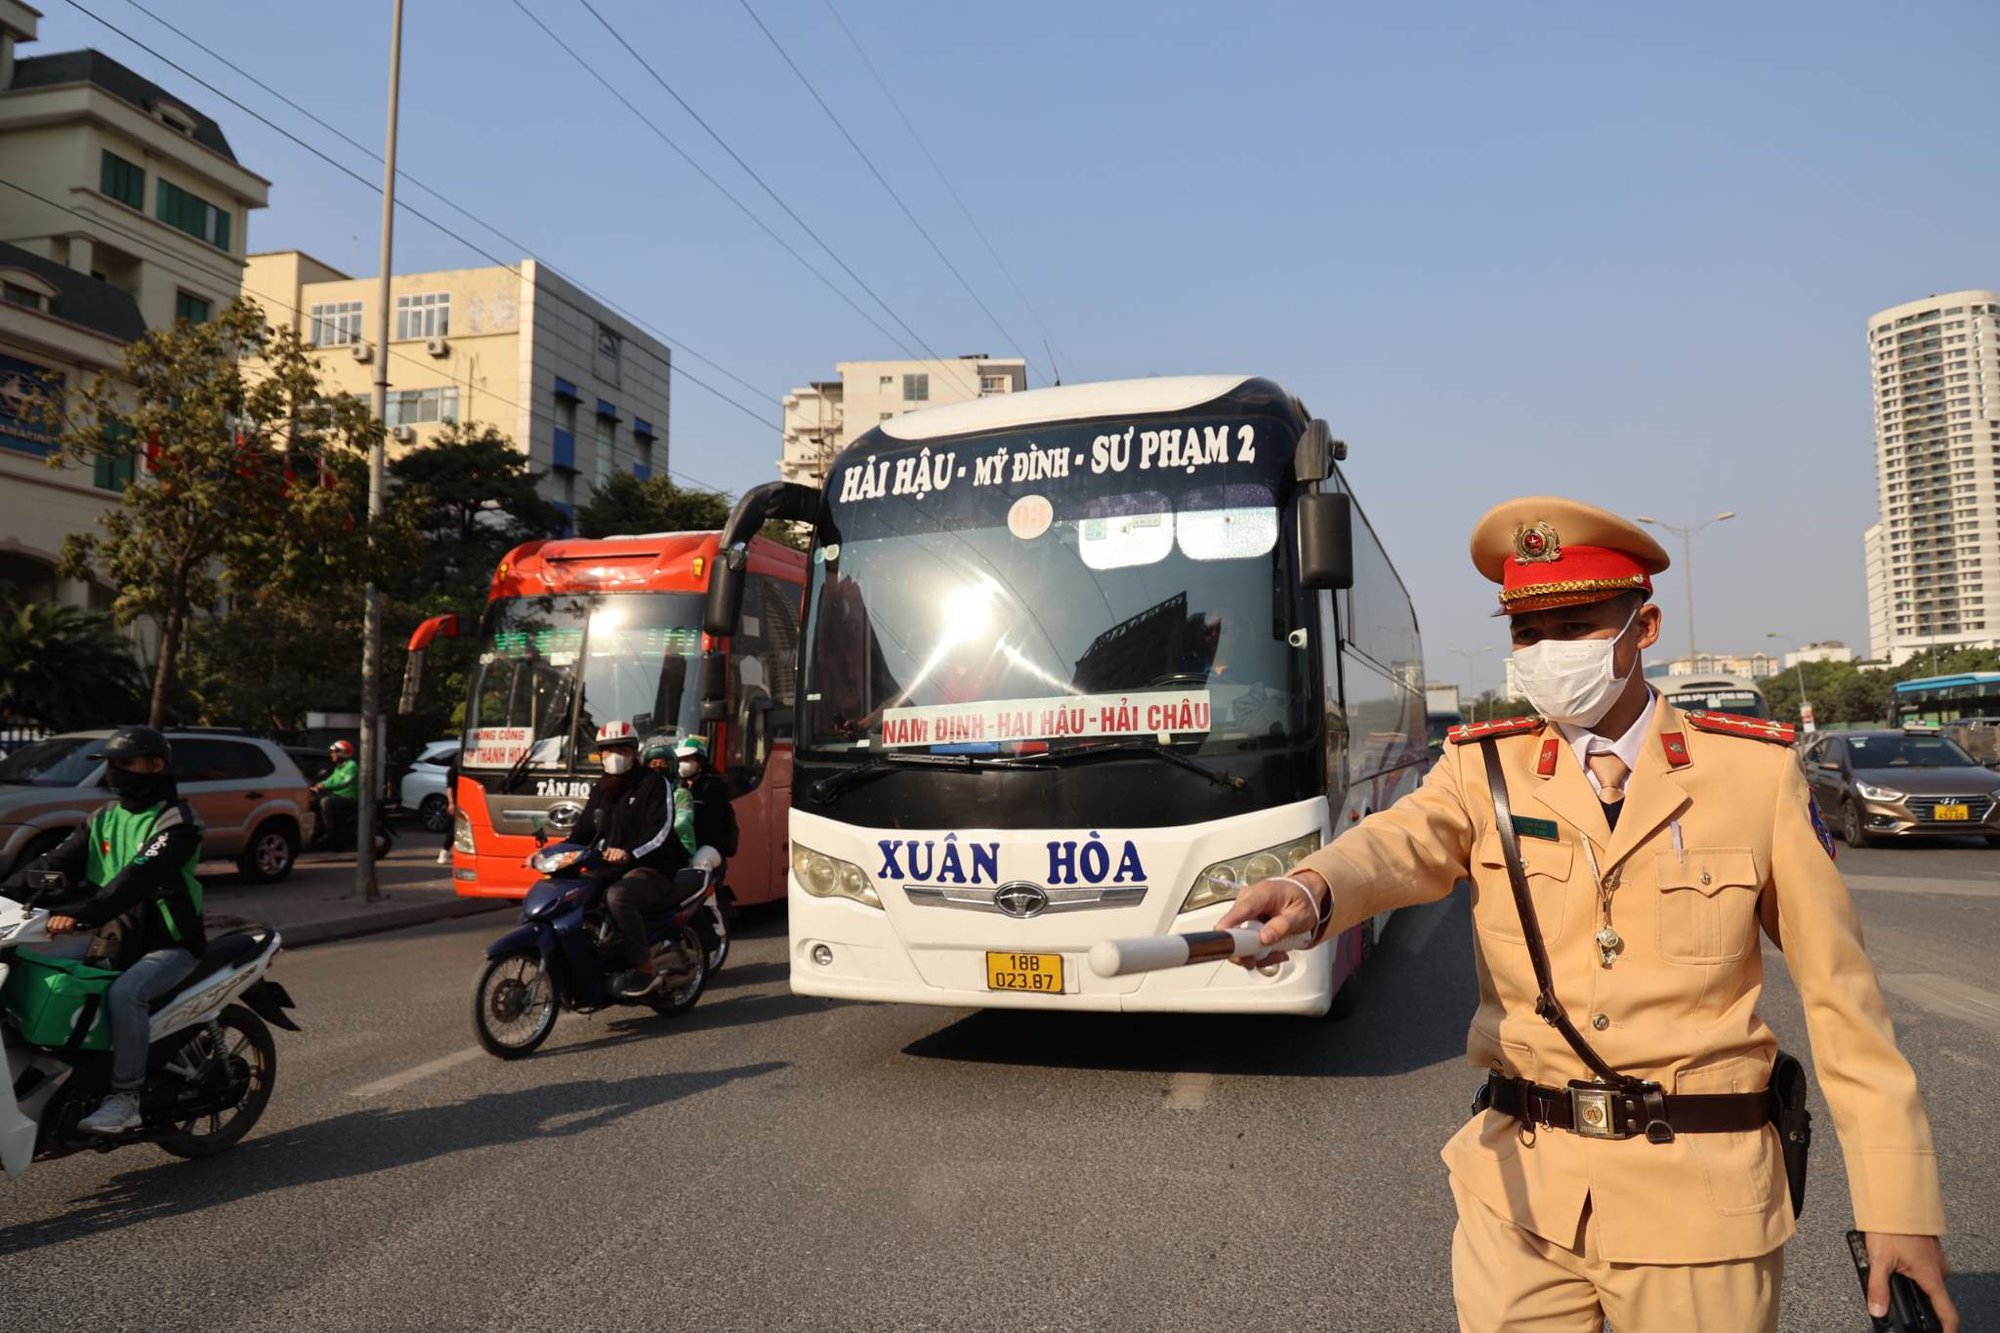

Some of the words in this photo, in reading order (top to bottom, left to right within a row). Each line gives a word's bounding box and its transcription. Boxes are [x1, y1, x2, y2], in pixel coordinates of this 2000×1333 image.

[839, 454, 891, 504] HẢI
[891, 446, 956, 501] HẬU
[972, 447, 1010, 487] MỸ
[1010, 442, 1071, 483] ĐÌNH
[1091, 426, 1135, 475] SƯ
[1138, 425, 1230, 475] PHẠM
[1237, 424, 1256, 465] 2
[883, 718, 929, 744] NAM
[1100, 697, 1138, 732] HẢI
[1147, 698, 1209, 731] CHÂU
[536, 778, 568, 797] TÂN
[878, 832, 1000, 884] XUÂN
[1046, 830, 1147, 884] HÒA
[1010, 955, 1040, 971] 18B
[995, 972, 1054, 990] 023.87
